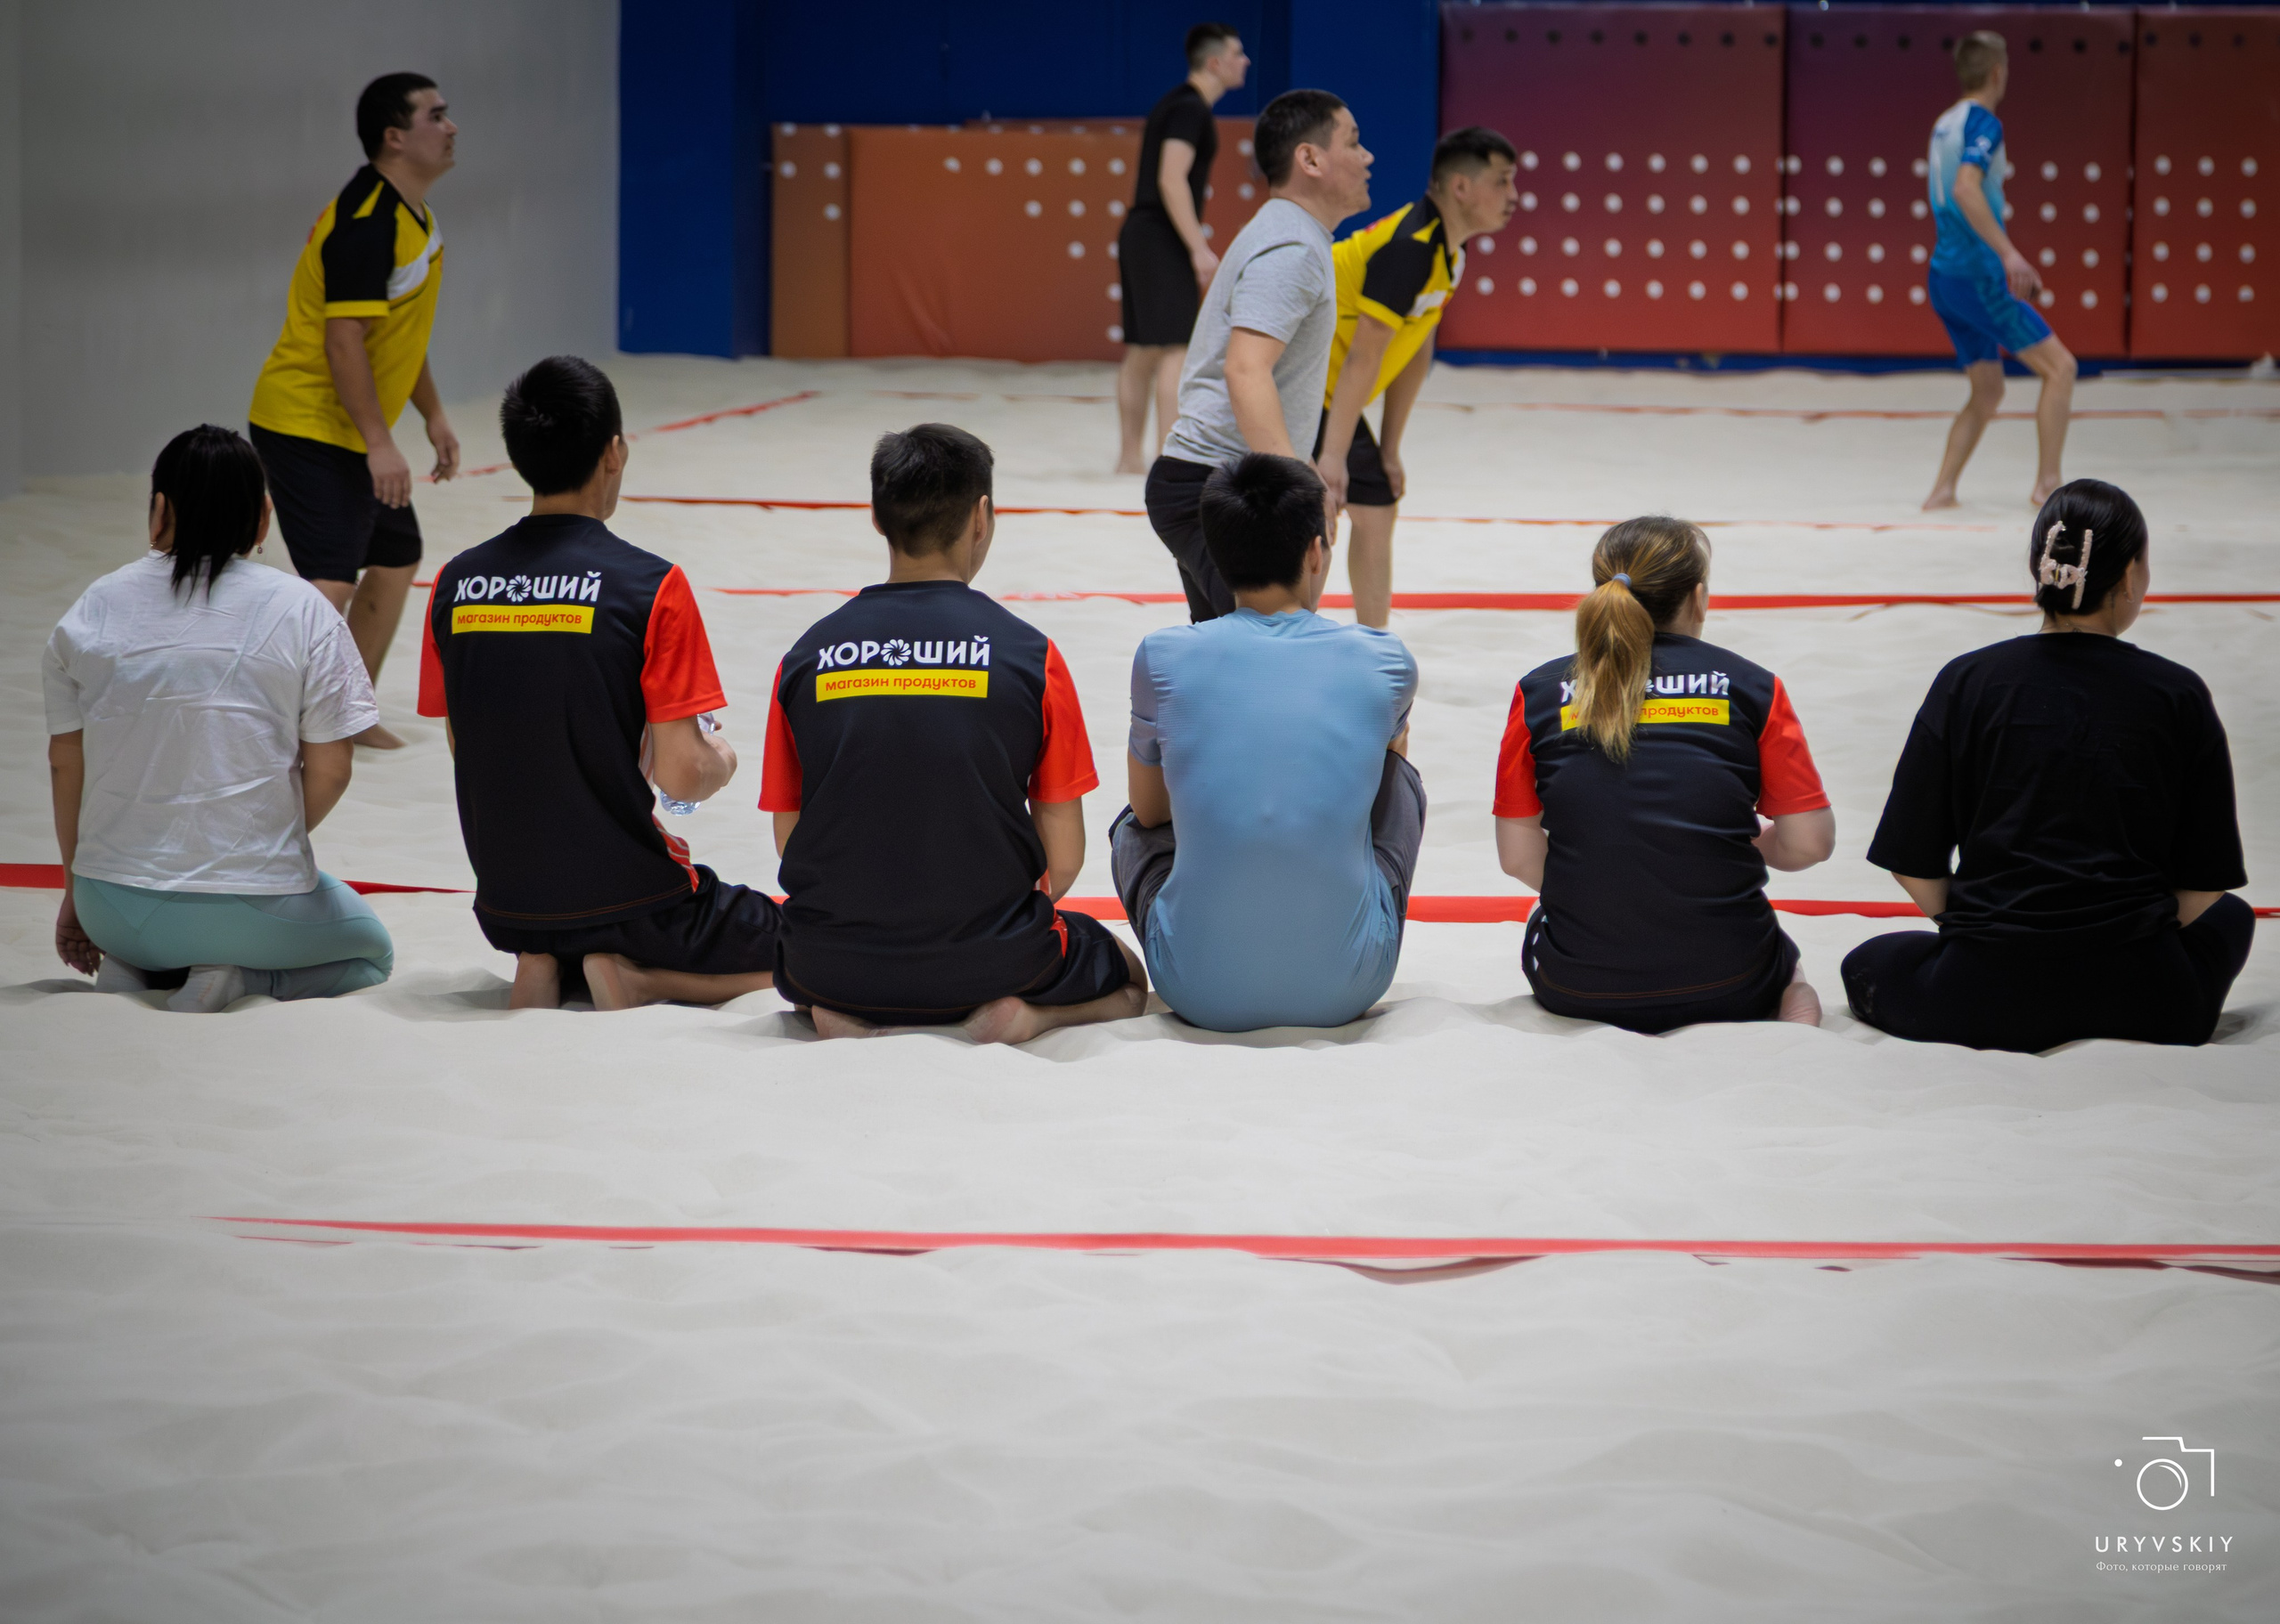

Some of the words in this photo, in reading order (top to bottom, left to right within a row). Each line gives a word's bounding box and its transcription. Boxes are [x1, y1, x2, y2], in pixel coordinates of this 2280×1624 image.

[457, 613, 510, 625] магазин
[513, 613, 582, 628] продуктов
[826, 678, 889, 692] магазин
[893, 678, 976, 691] продуктов
